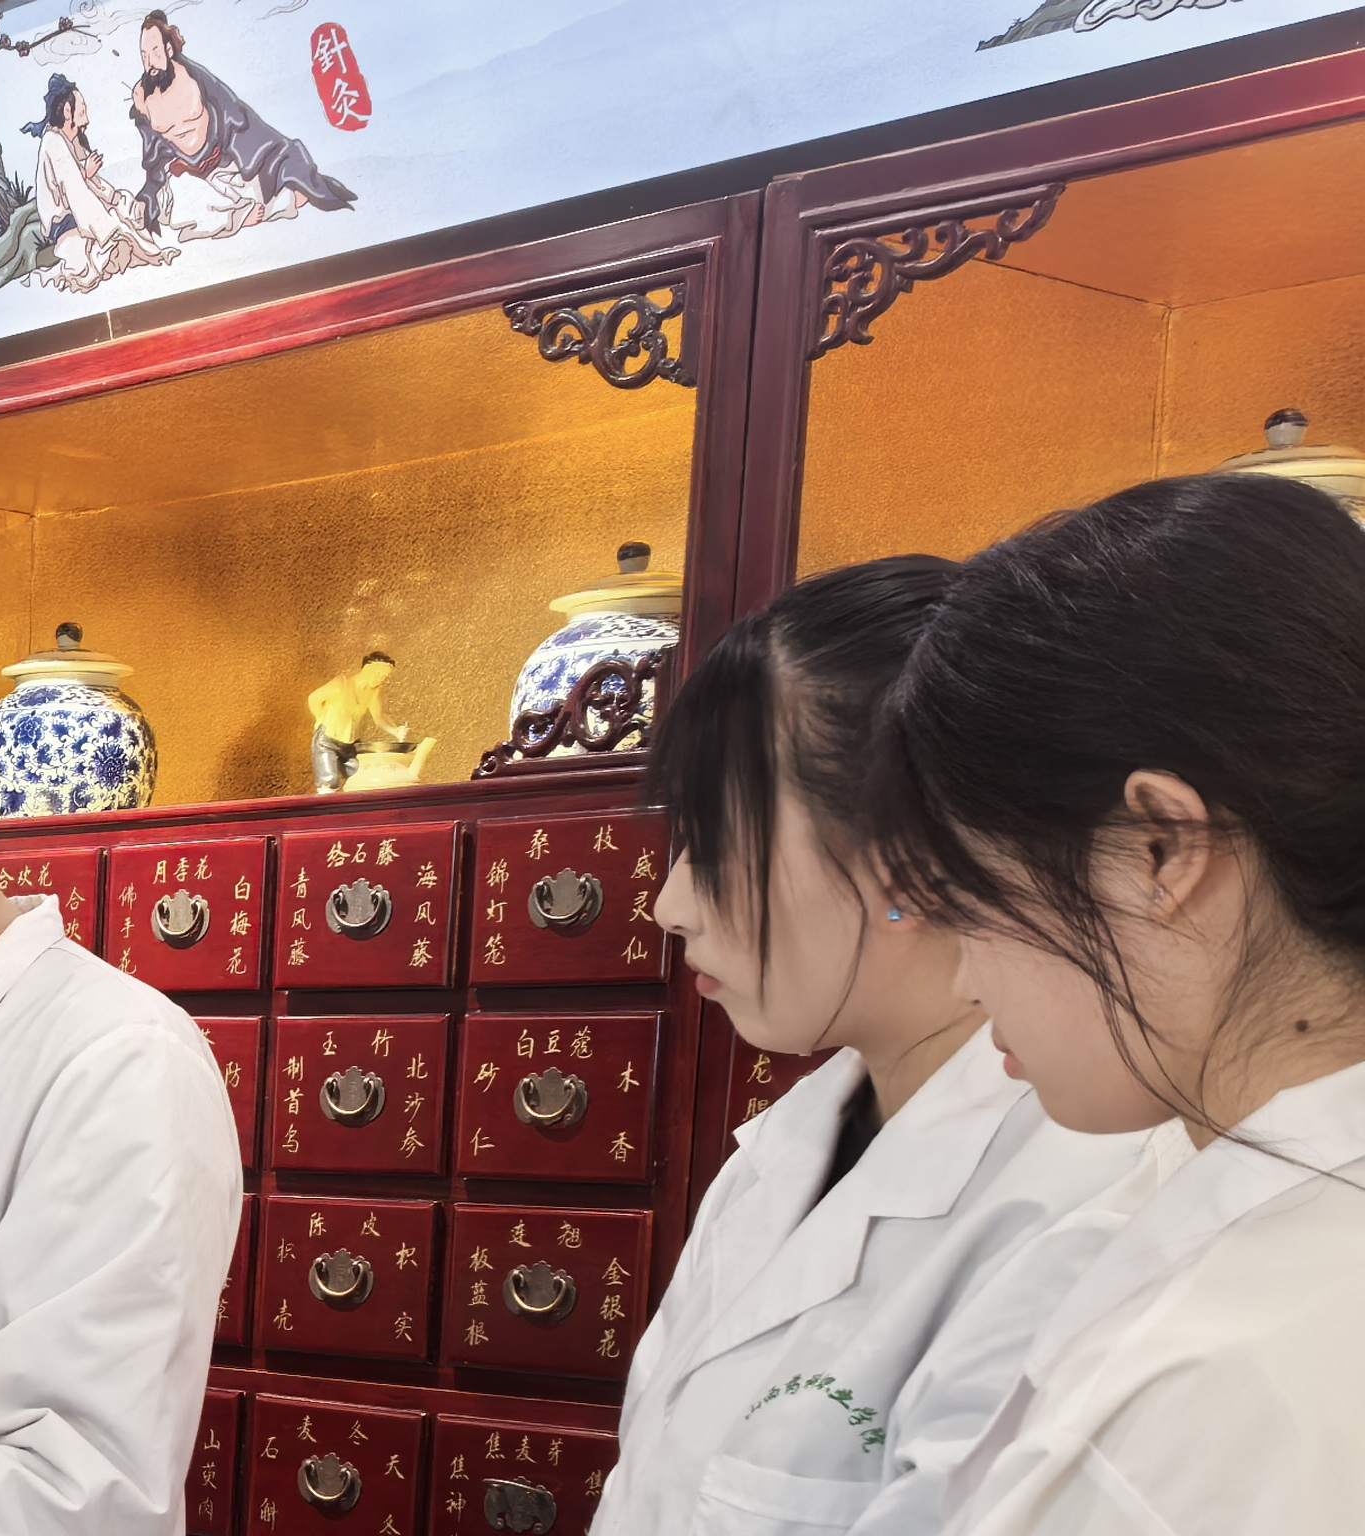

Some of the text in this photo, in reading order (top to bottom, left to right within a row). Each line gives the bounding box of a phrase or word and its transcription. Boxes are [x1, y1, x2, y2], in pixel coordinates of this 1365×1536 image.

[314, 29, 370, 126] 針灸
[152, 855, 213, 885] 月季花
[326, 838, 400, 868] 络石藤
[524, 824, 620, 860] 桑枝
[116, 882, 137, 978] 佛手花
[226, 875, 252, 975] 白梅花
[287, 866, 312, 966] 青风藤
[408, 861, 438, 968] 海风藤
[620, 847, 659, 965] 威灵仙
[322, 1028, 394, 1057] 玉竹
[517, 1025, 593, 1059] 白豆蔻
[281, 1055, 304, 1153] 制首乌
[399, 1052, 429, 1159] 北沙参
[469, 1061, 501, 1157] 砂仁
[608, 1060, 640, 1163] 木香
[308, 1211, 381, 1238] 陈皮
[508, 1219, 582, 1249] 连翘
[272, 1237, 296, 1331] 枳壳
[394, 1241, 418, 1342] 枳实
[464, 1245, 494, 1346] 板蓝根
[596, 1256, 631, 1358] 金银花
[198, 1427, 221, 1522] 山萸肉
[296, 1414, 369, 1446] 麦冬
[485, 1429, 566, 1466] 焦麦芽
[260, 1436, 279, 1531] 石斛
